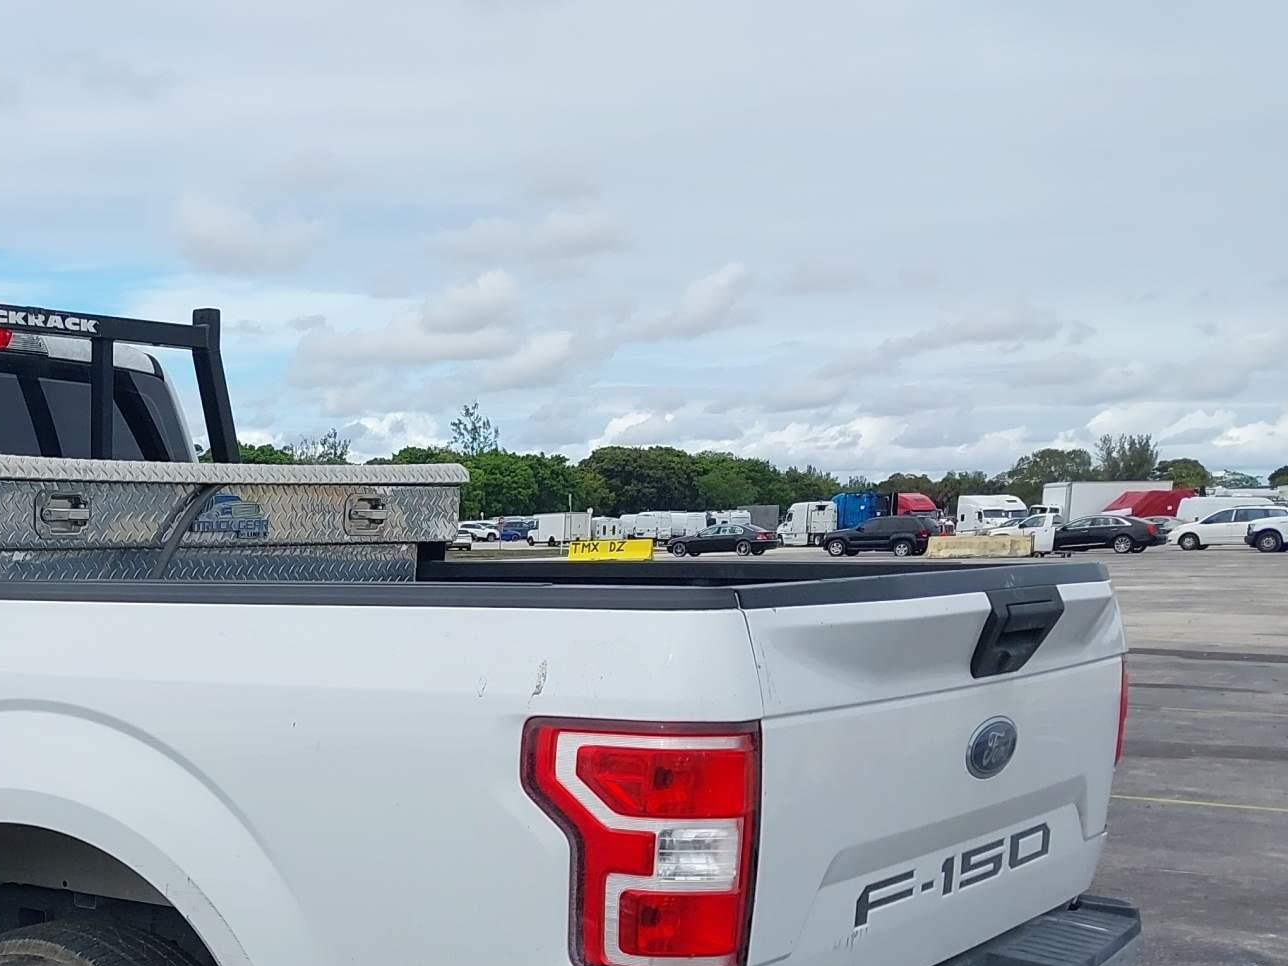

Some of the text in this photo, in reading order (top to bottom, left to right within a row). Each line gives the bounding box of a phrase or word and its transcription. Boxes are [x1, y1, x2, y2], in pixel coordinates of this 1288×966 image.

[238, 519, 269, 531] GEAR
[571, 542, 600, 554] TMX
[854, 822, 1051, 928] F-150
